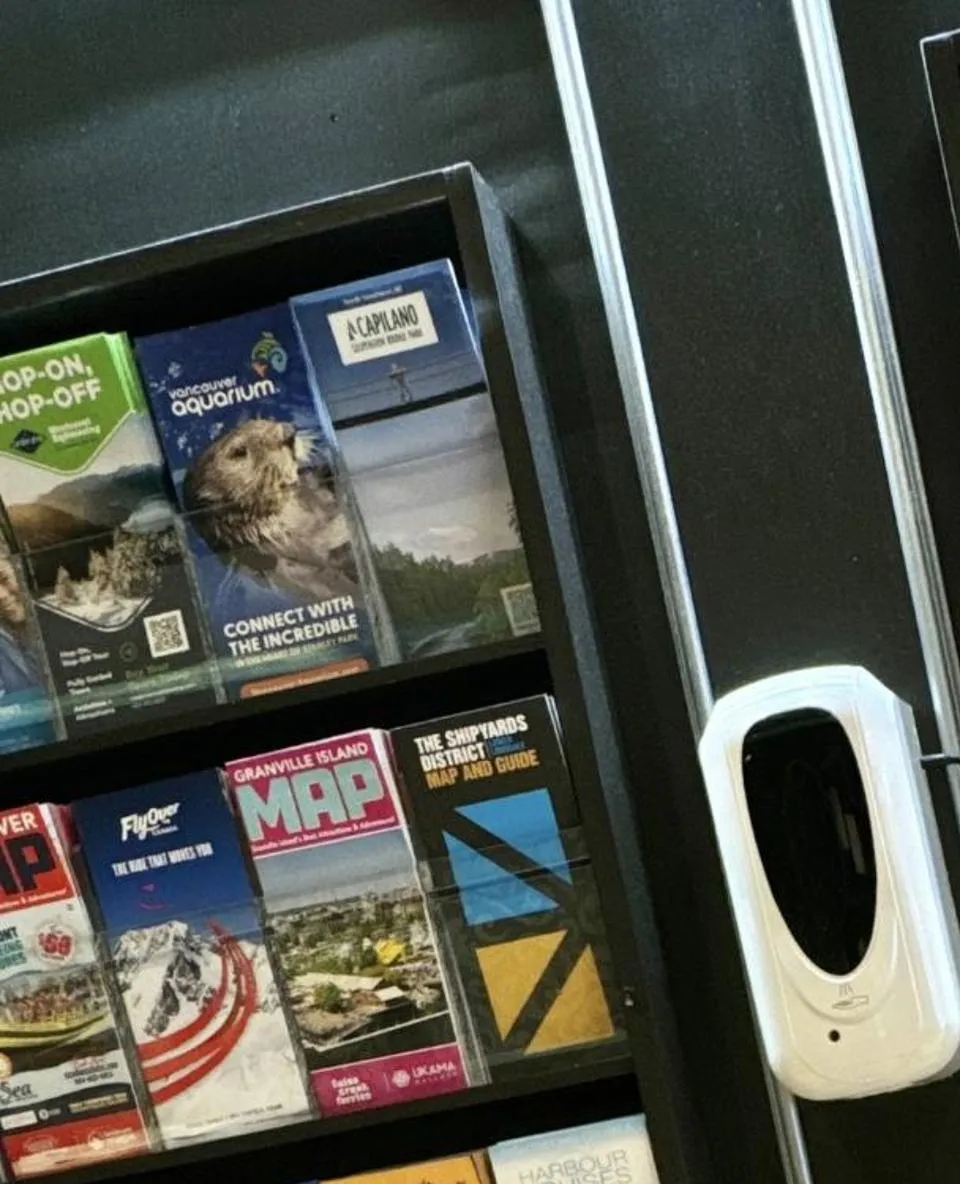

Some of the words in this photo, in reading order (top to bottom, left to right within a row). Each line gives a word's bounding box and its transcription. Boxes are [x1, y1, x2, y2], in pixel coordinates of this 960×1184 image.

[356, 304, 419, 339] CAPILANO
[168, 375, 237, 401] vancouver
[171, 379, 275, 417] aquarium
[224, 607, 305, 638] CONNECT
[307, 595, 355, 619] WITH
[228, 637, 262, 658] THE
[264, 613, 359, 649] INCREDIBLE
[413, 736, 444, 754] THE
[445, 714, 529, 748] SHIPYARDS
[233, 755, 314, 783] GRANVILLE
[315, 742, 369, 768] ISLAND
[418, 744, 486, 772] DISTRICT
[425, 770, 461, 790] MAP
[463, 761, 494, 781] AND
[495, 750, 541, 770] GUIDE
[235, 760, 384, 840] MAP
[119, 803, 180, 842] FlyOver
